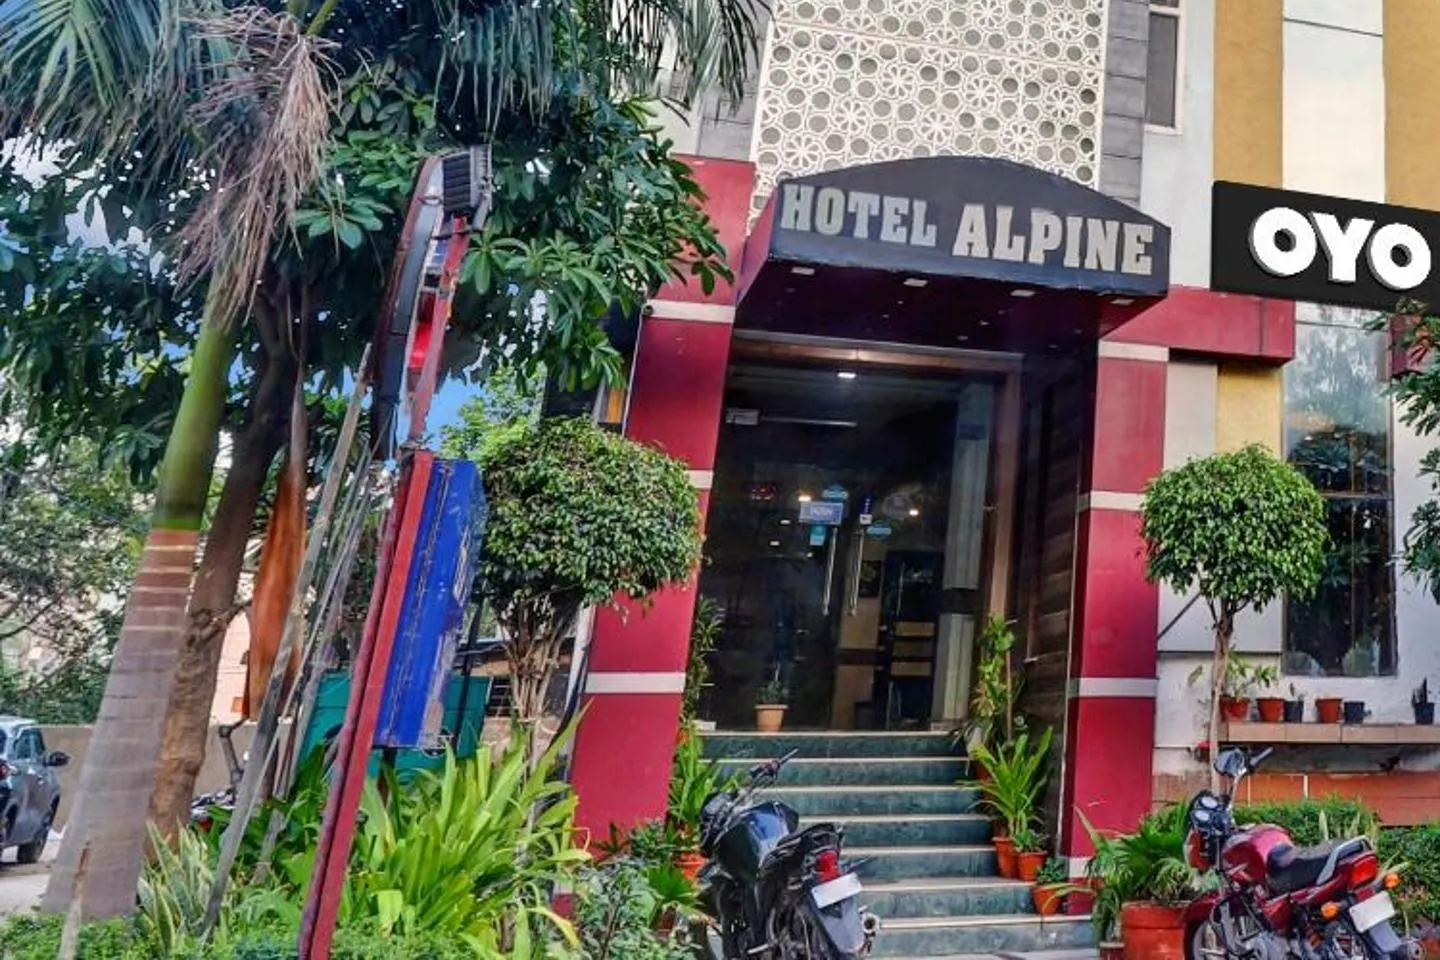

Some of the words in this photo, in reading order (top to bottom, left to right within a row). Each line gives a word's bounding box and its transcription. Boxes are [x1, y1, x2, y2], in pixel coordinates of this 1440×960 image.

[780, 183, 938, 247] HOTEL
[952, 203, 1154, 275] ALPINE
[1248, 206, 1432, 291] OYO
